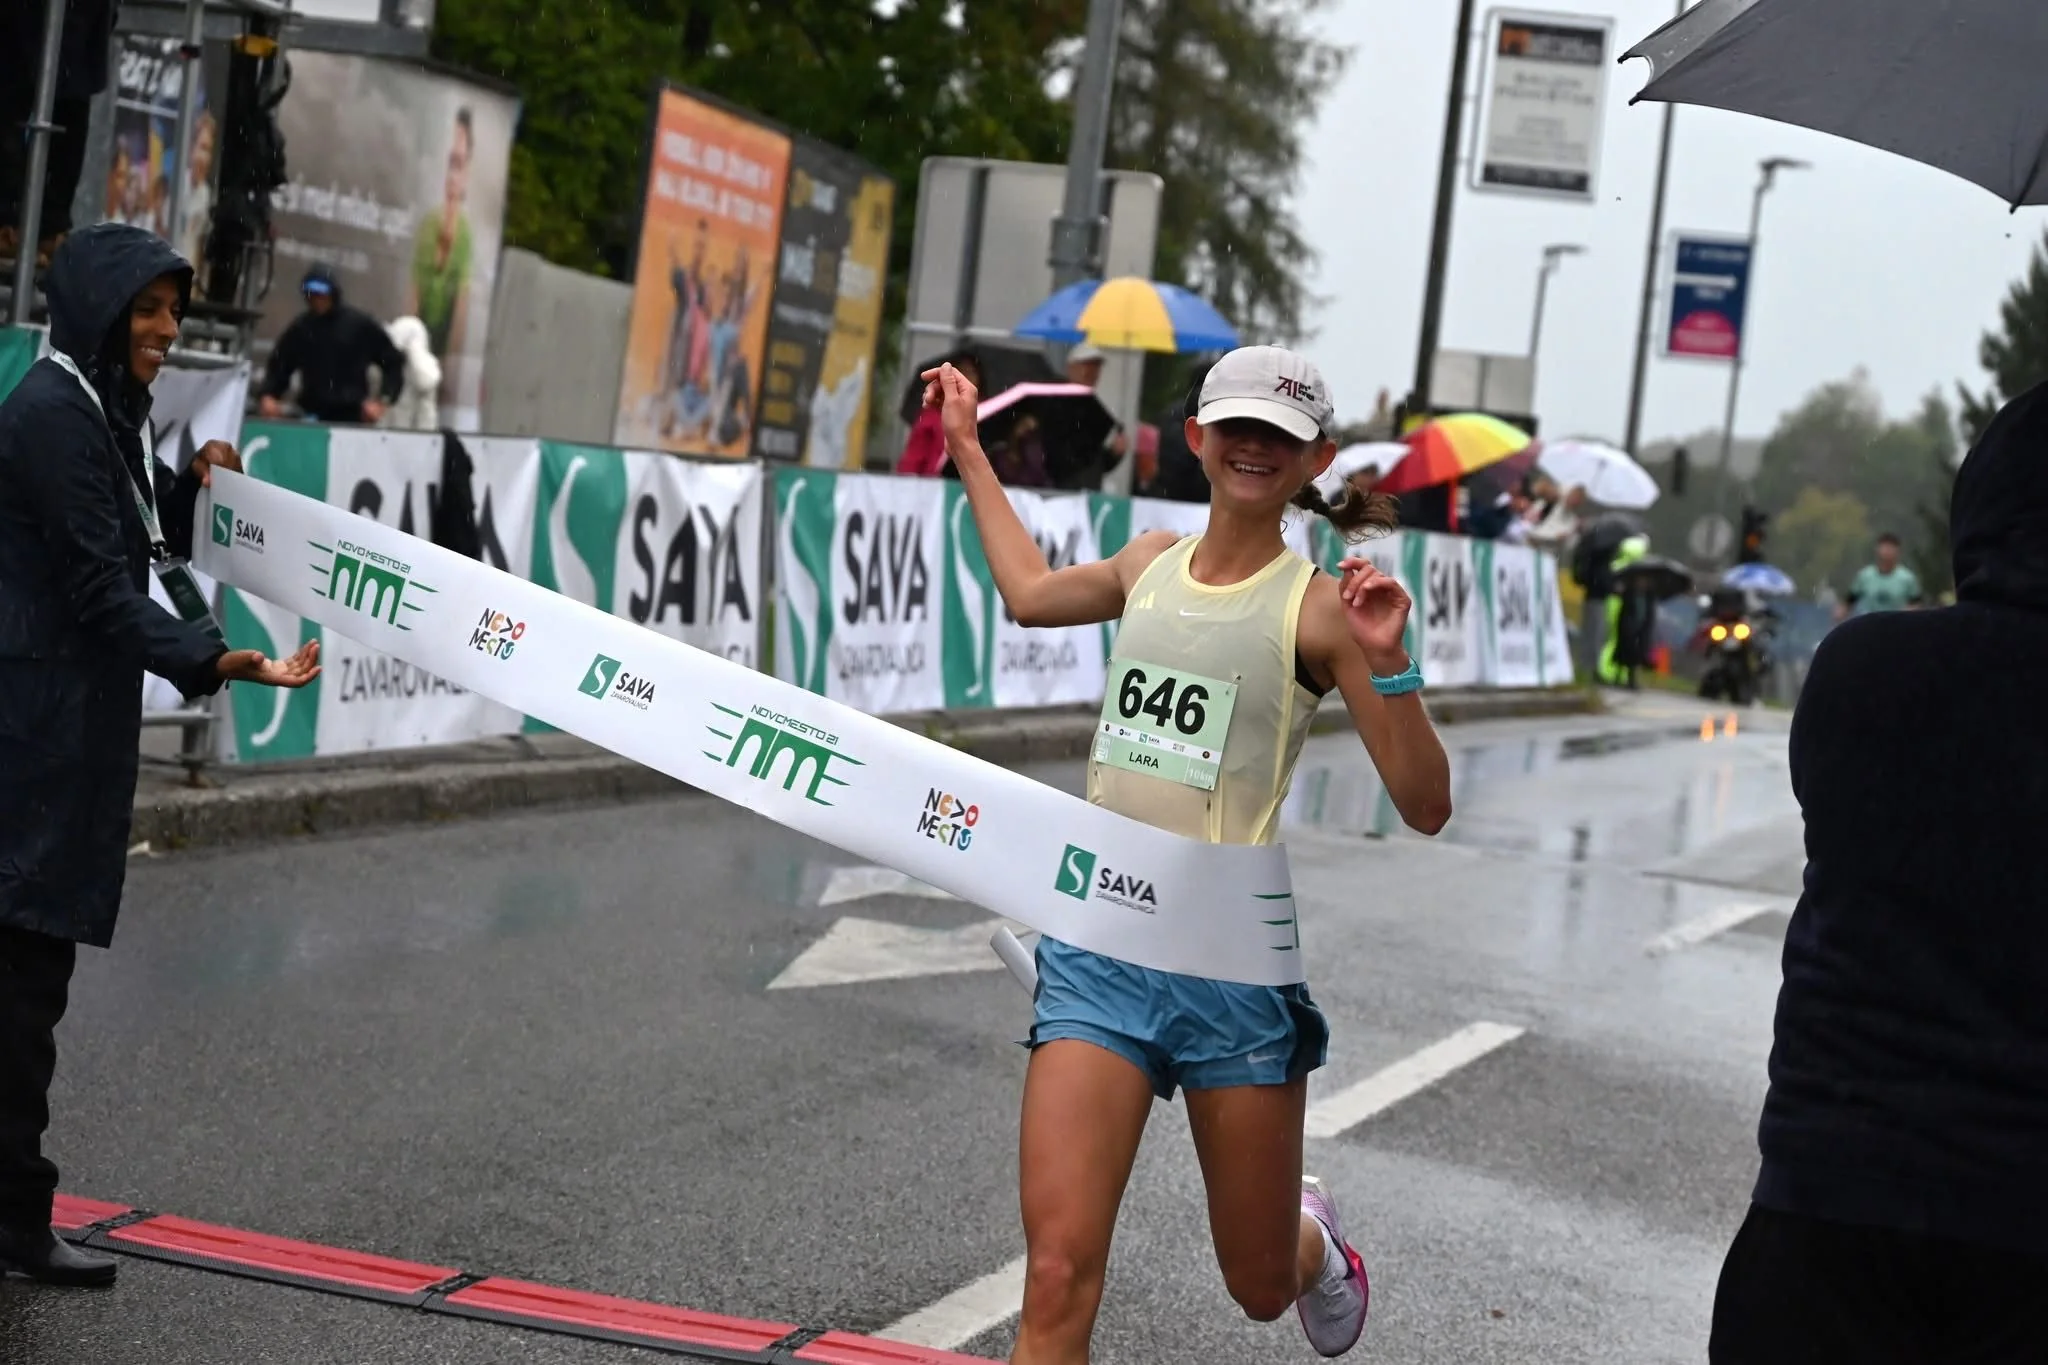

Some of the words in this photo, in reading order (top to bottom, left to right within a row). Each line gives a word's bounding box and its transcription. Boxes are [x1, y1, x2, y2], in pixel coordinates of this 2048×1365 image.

[236, 519, 264, 546] SAVA
[337, 539, 365, 556] NOVO
[366, 550, 400, 569] MESTO
[400, 563, 411, 574] 21
[843, 510, 930, 625] SAVA
[616, 672, 655, 703] SAVA
[1119, 668, 1209, 734] 646
[826, 734, 839, 745] 21
[1129, 752, 1159, 768] LARA
[1098, 868, 1157, 905] SAVA
